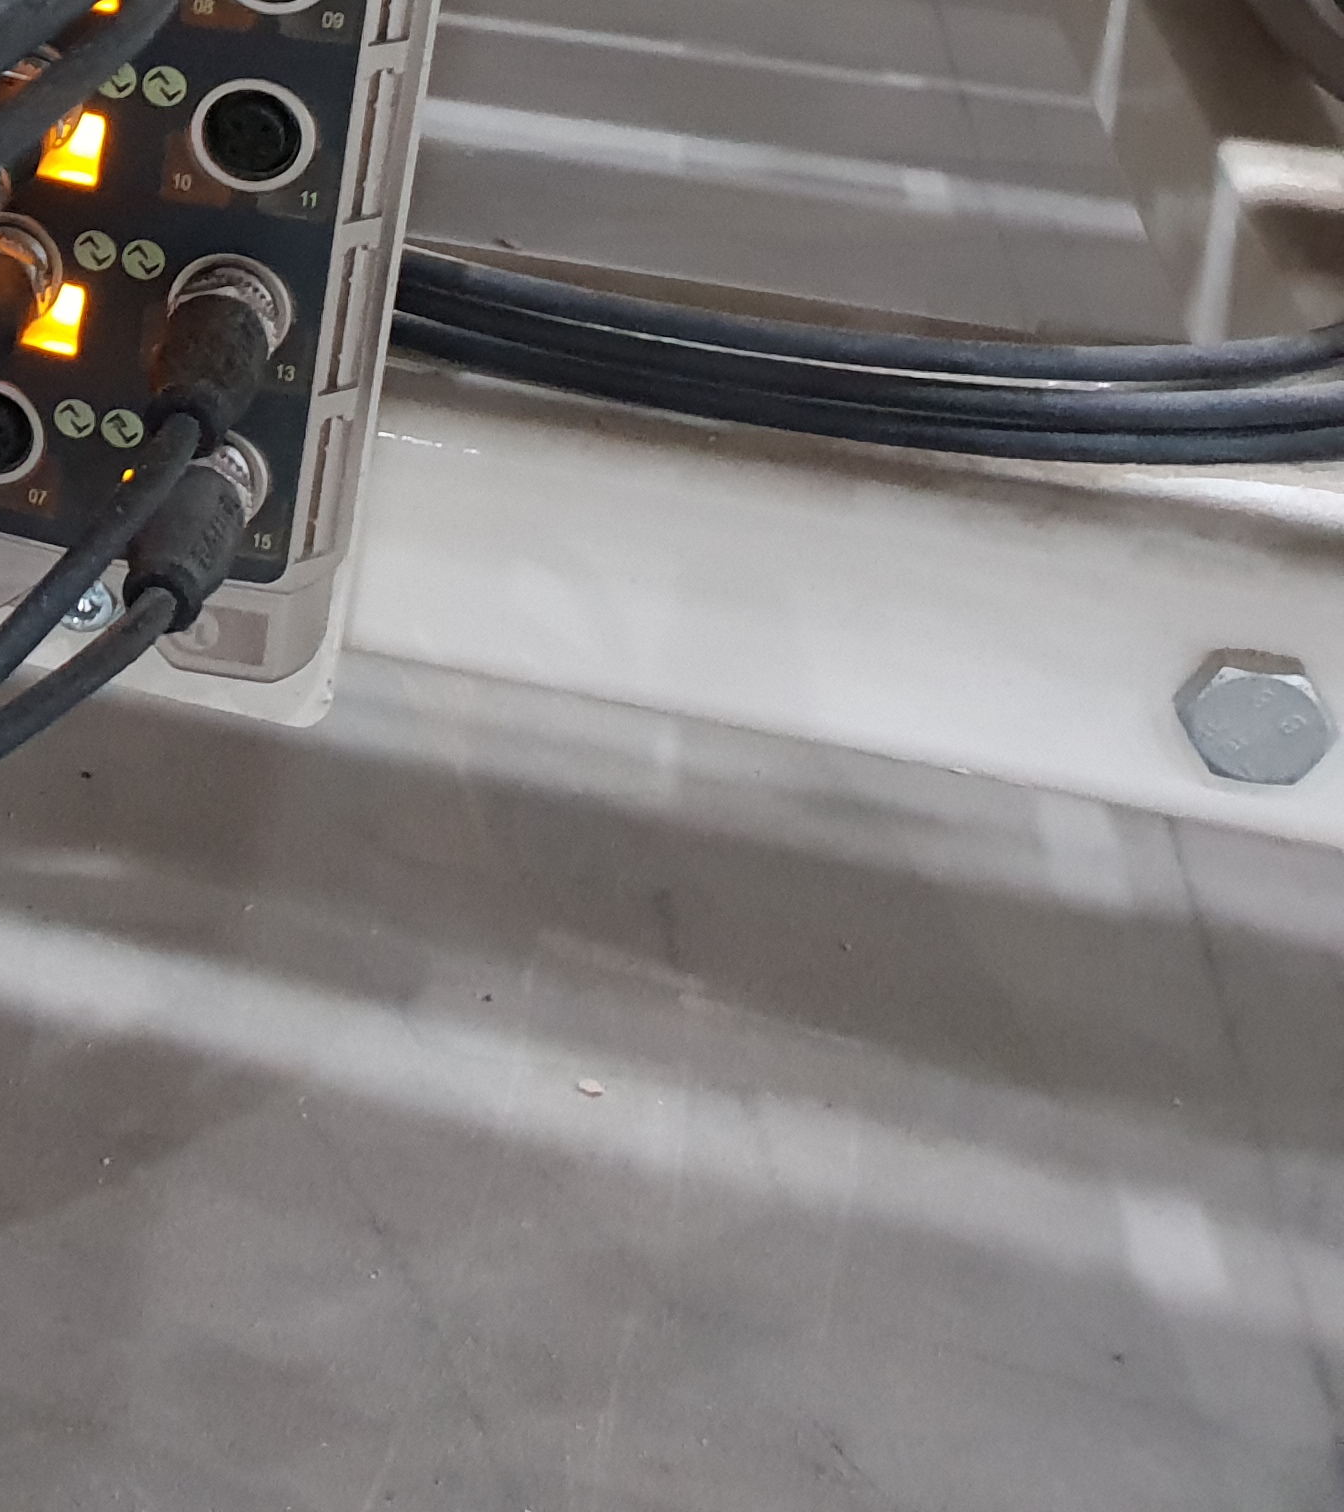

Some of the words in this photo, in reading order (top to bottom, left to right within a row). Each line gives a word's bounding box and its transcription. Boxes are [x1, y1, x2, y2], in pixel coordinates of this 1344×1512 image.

[321, 11, 346, 30] 09
[173, 173, 193, 191] 10
[299, 192, 319, 209] 11
[276, 363, 296, 382] 13
[28, 489, 49, 507] 07
[252, 532, 273, 550] 15
